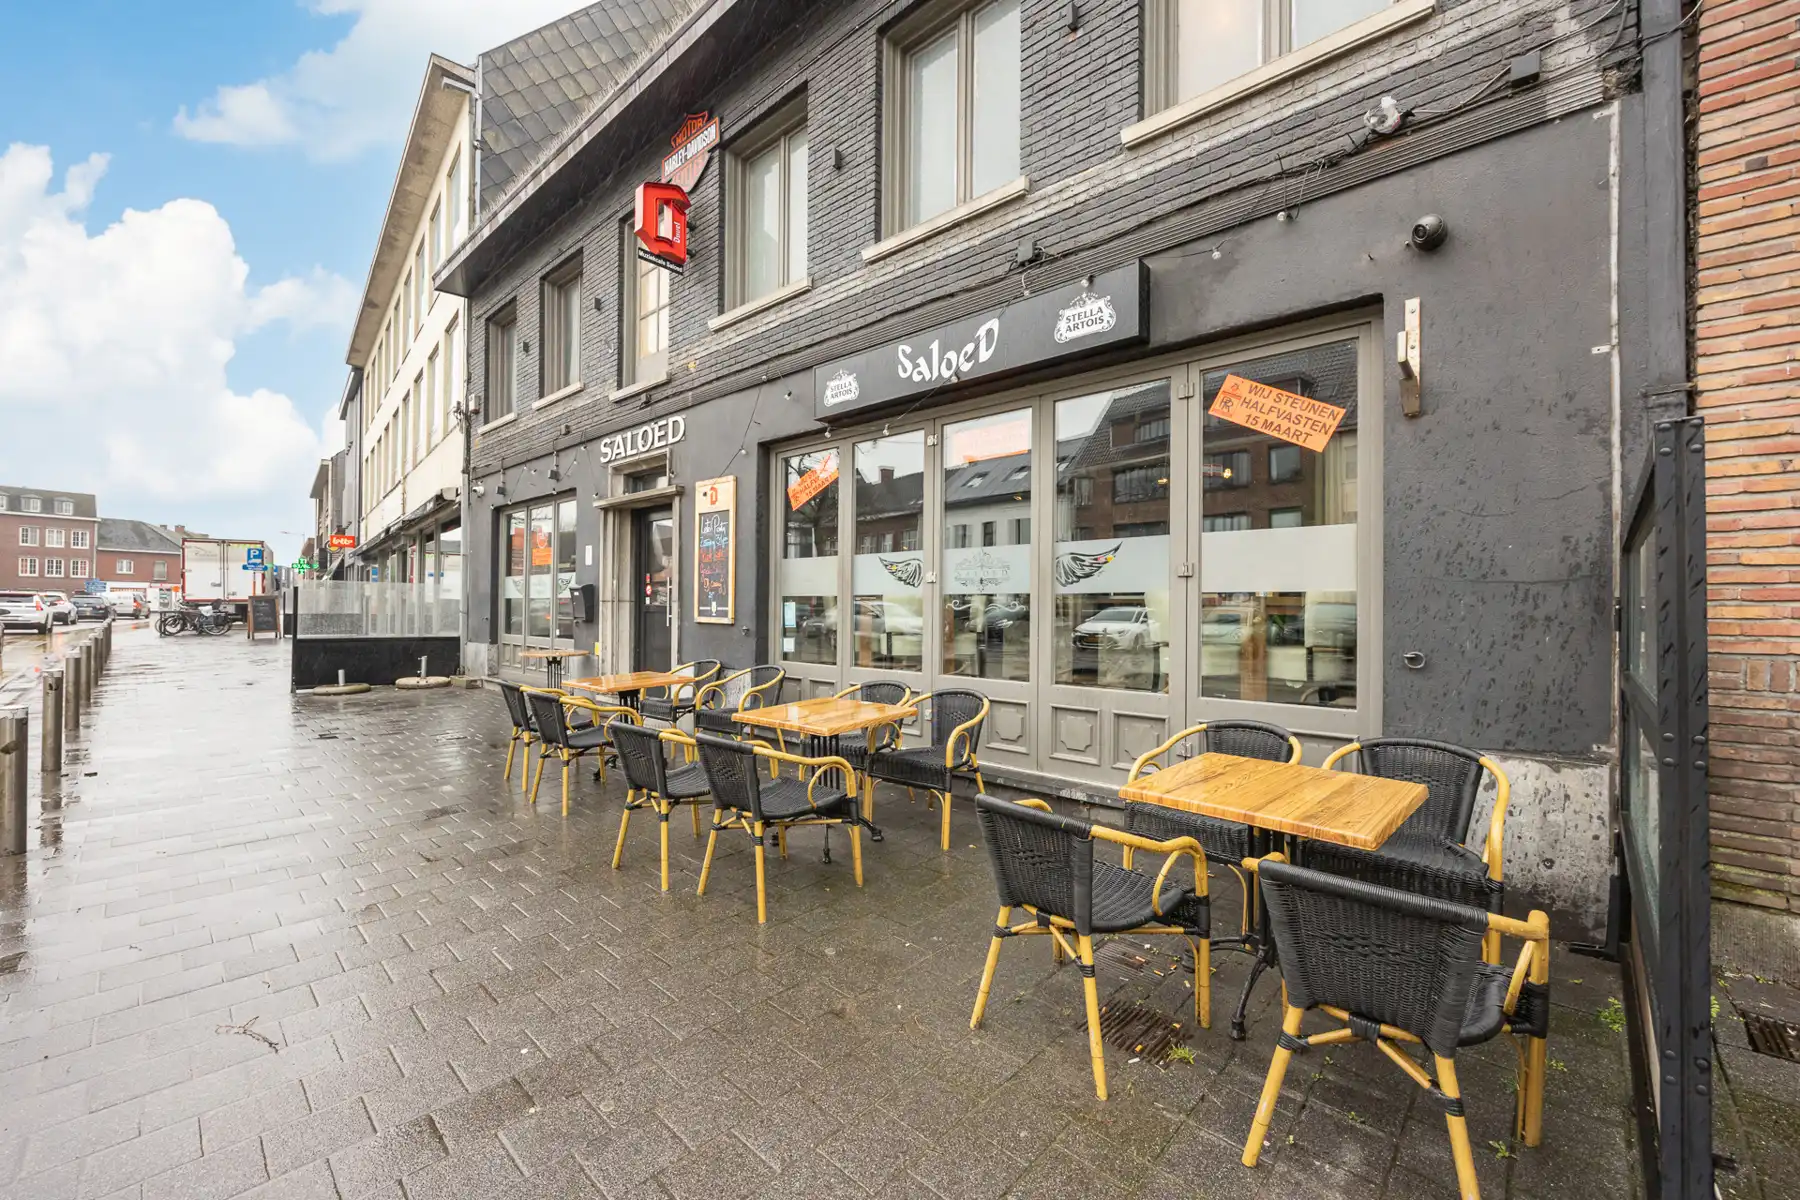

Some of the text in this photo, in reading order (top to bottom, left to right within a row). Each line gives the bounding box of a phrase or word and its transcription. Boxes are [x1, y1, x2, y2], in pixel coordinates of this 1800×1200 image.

[675, 118, 703, 147] MOTOR
[664, 122, 717, 177] HARLEY-DAVIDSON
[673, 221, 681, 244] Duvel
[1065, 306, 1104, 325] STELLA
[1065, 315, 1105, 333] ARTOIS
[898, 318, 1000, 383] SaloeD
[830, 381, 852, 393] STELLA
[830, 388, 853, 399] ARTOIS
[1240, 396, 1332, 436] HALFVASTEN
[1248, 384, 1340, 421] WIJ STEUNEN
[600, 415, 685, 463] SALOED
[1245, 413, 1313, 444] 15 MAART
[250, 549, 259, 559] P
